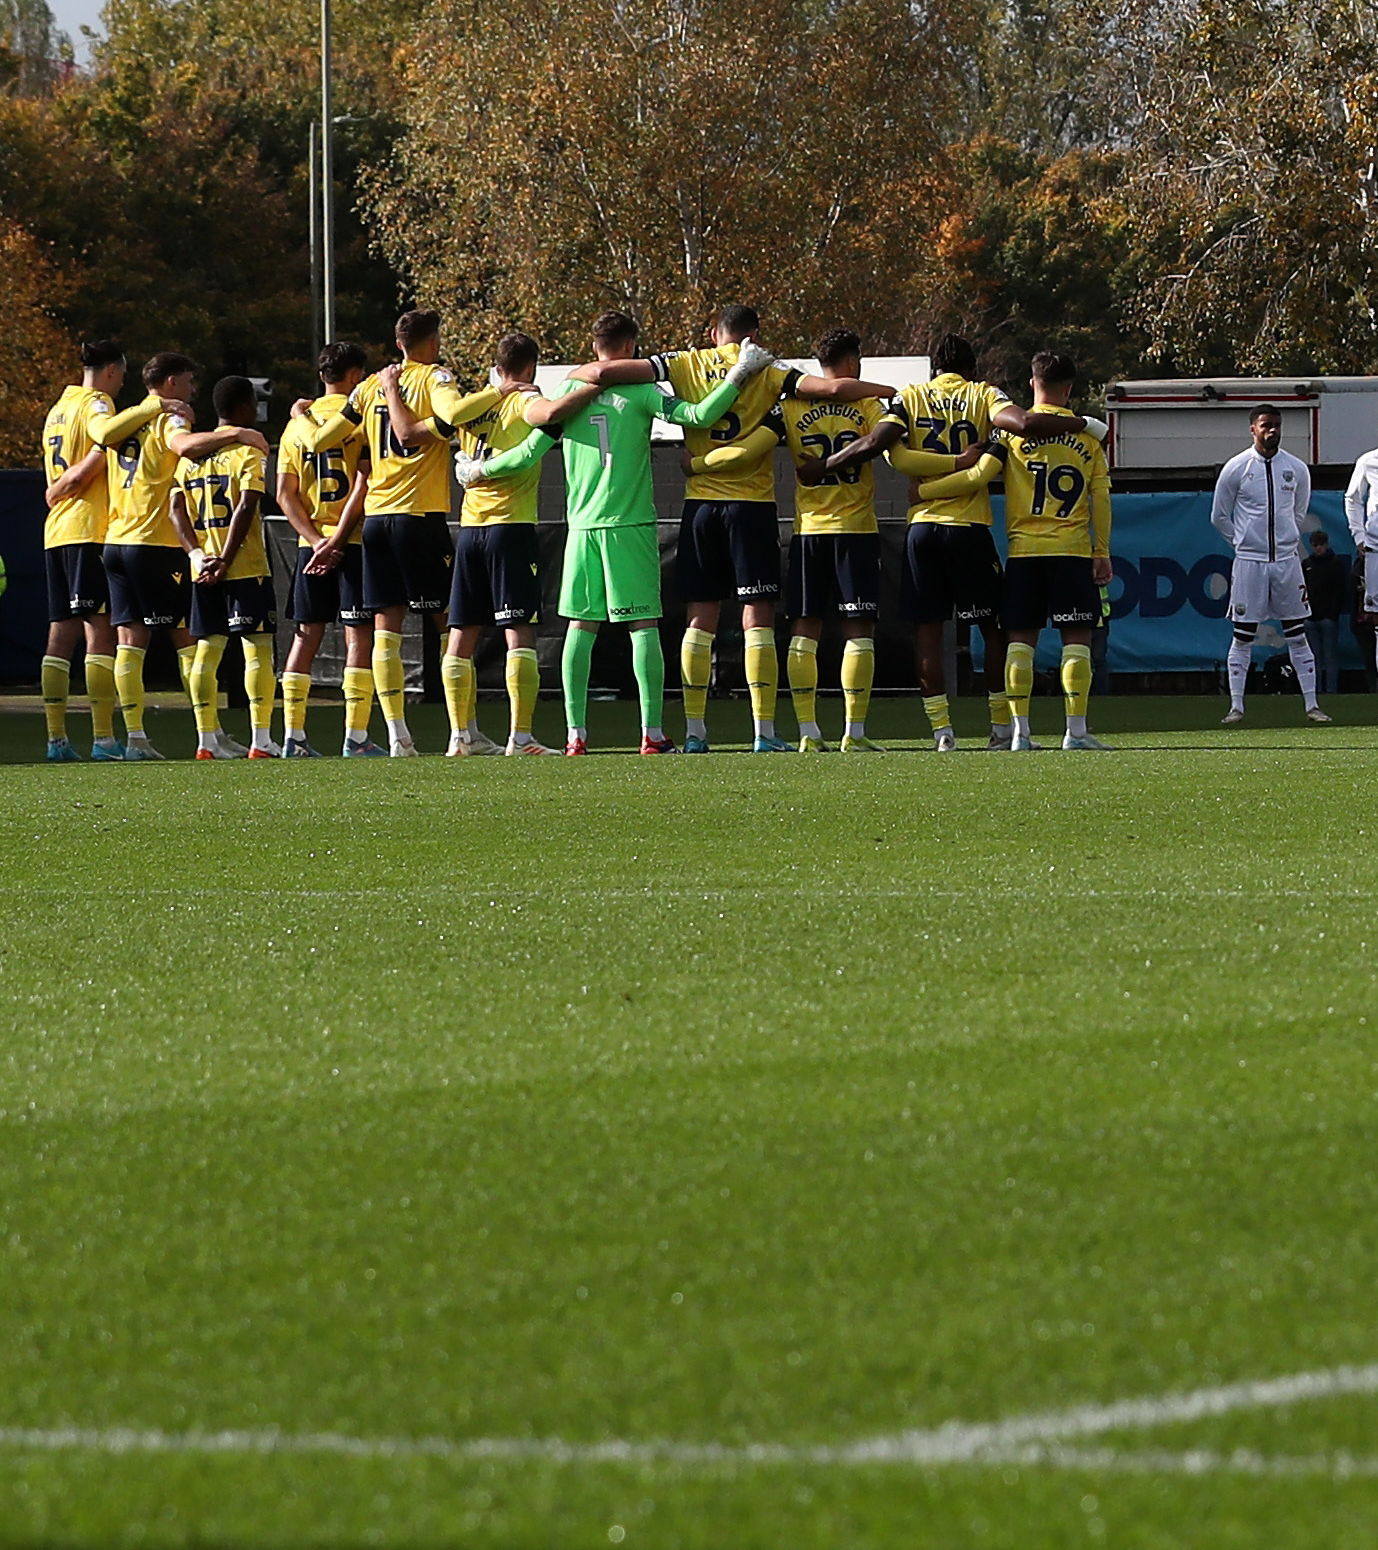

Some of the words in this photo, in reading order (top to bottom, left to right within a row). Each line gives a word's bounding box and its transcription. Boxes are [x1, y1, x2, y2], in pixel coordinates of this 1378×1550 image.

[589, 414, 613, 468] 1
[796, 403, 866, 432] RODRIGUES
[119, 437, 141, 489] 9
[1020, 427, 1092, 464] GOODRHAM
[1027, 460, 1086, 519] 19
